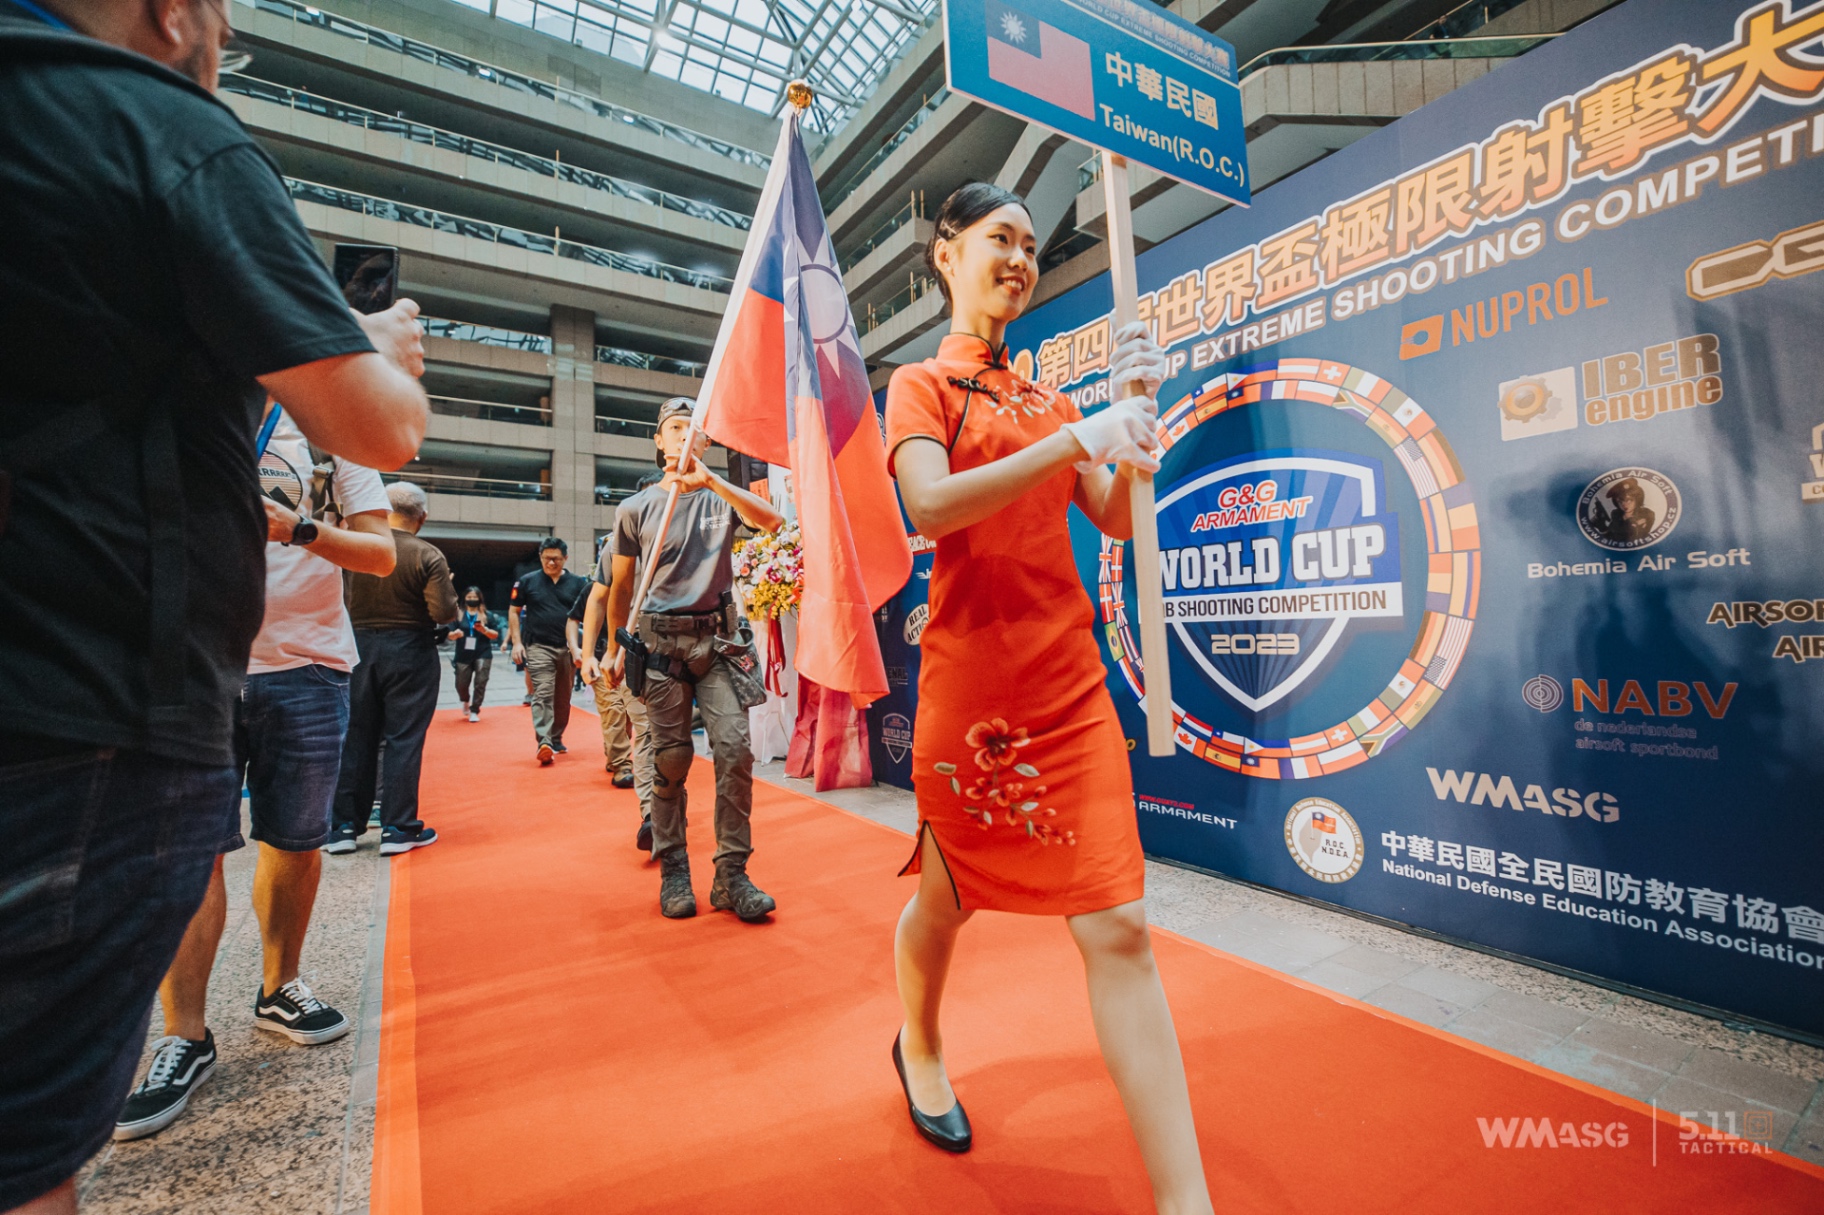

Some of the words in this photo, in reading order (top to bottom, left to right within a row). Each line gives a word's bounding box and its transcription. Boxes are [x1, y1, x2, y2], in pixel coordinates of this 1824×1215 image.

[1121, 18, 1154, 39] EXTREME
[1155, 34, 1189, 56] SHOOTING
[1189, 52, 1231, 77] COMPETITION
[1105, 51, 1219, 130] 中華民國
[1099, 103, 1245, 187] Taiwan(R.O.C.)
[1040, 10, 1824, 388] 第四世界盃極限射擊大
[1193, 302, 1324, 368] EXTREME
[1334, 222, 1541, 317] SHOOTING
[1451, 267, 1608, 346] NUPROL
[1582, 333, 1722, 400] IBER
[1584, 375, 1723, 426] engine
[1219, 480, 1278, 510] G&G
[1582, 472, 1623, 505] Bohemia
[1628, 470, 1648, 479] Air
[1650, 475, 1673, 495] Soft
[1191, 495, 1314, 532] ARMAMENT
[1580, 507, 1677, 548] www.airsoftshop.cz
[1292, 522, 1387, 583] CUP
[1527, 558, 1627, 579] Bohemia
[1637, 554, 1676, 572] Air
[1687, 547, 1751, 569] Soft
[908, 605, 927, 627] REAL
[1178, 598, 1254, 617] SHOOTING
[1258, 590, 1387, 614] COMPETITION
[1211, 633, 1300, 655] 2023
[1572, 678, 1738, 719] NABV
[1574, 718, 1594, 732] de
[1597, 721, 1697, 739] nederlandse
[1575, 737, 1625, 752] airsoft
[1630, 743, 1719, 760] sportbond
[1139, 801, 1237, 829] ARMAMENT
[1425, 767, 1620, 823] WMASG
[1381, 830, 1824, 944] 中華民國全民國防教育協會
[1382, 857, 1452, 888] National
[1456, 874, 1537, 907] Defense
[1542, 892, 1658, 932] Education
